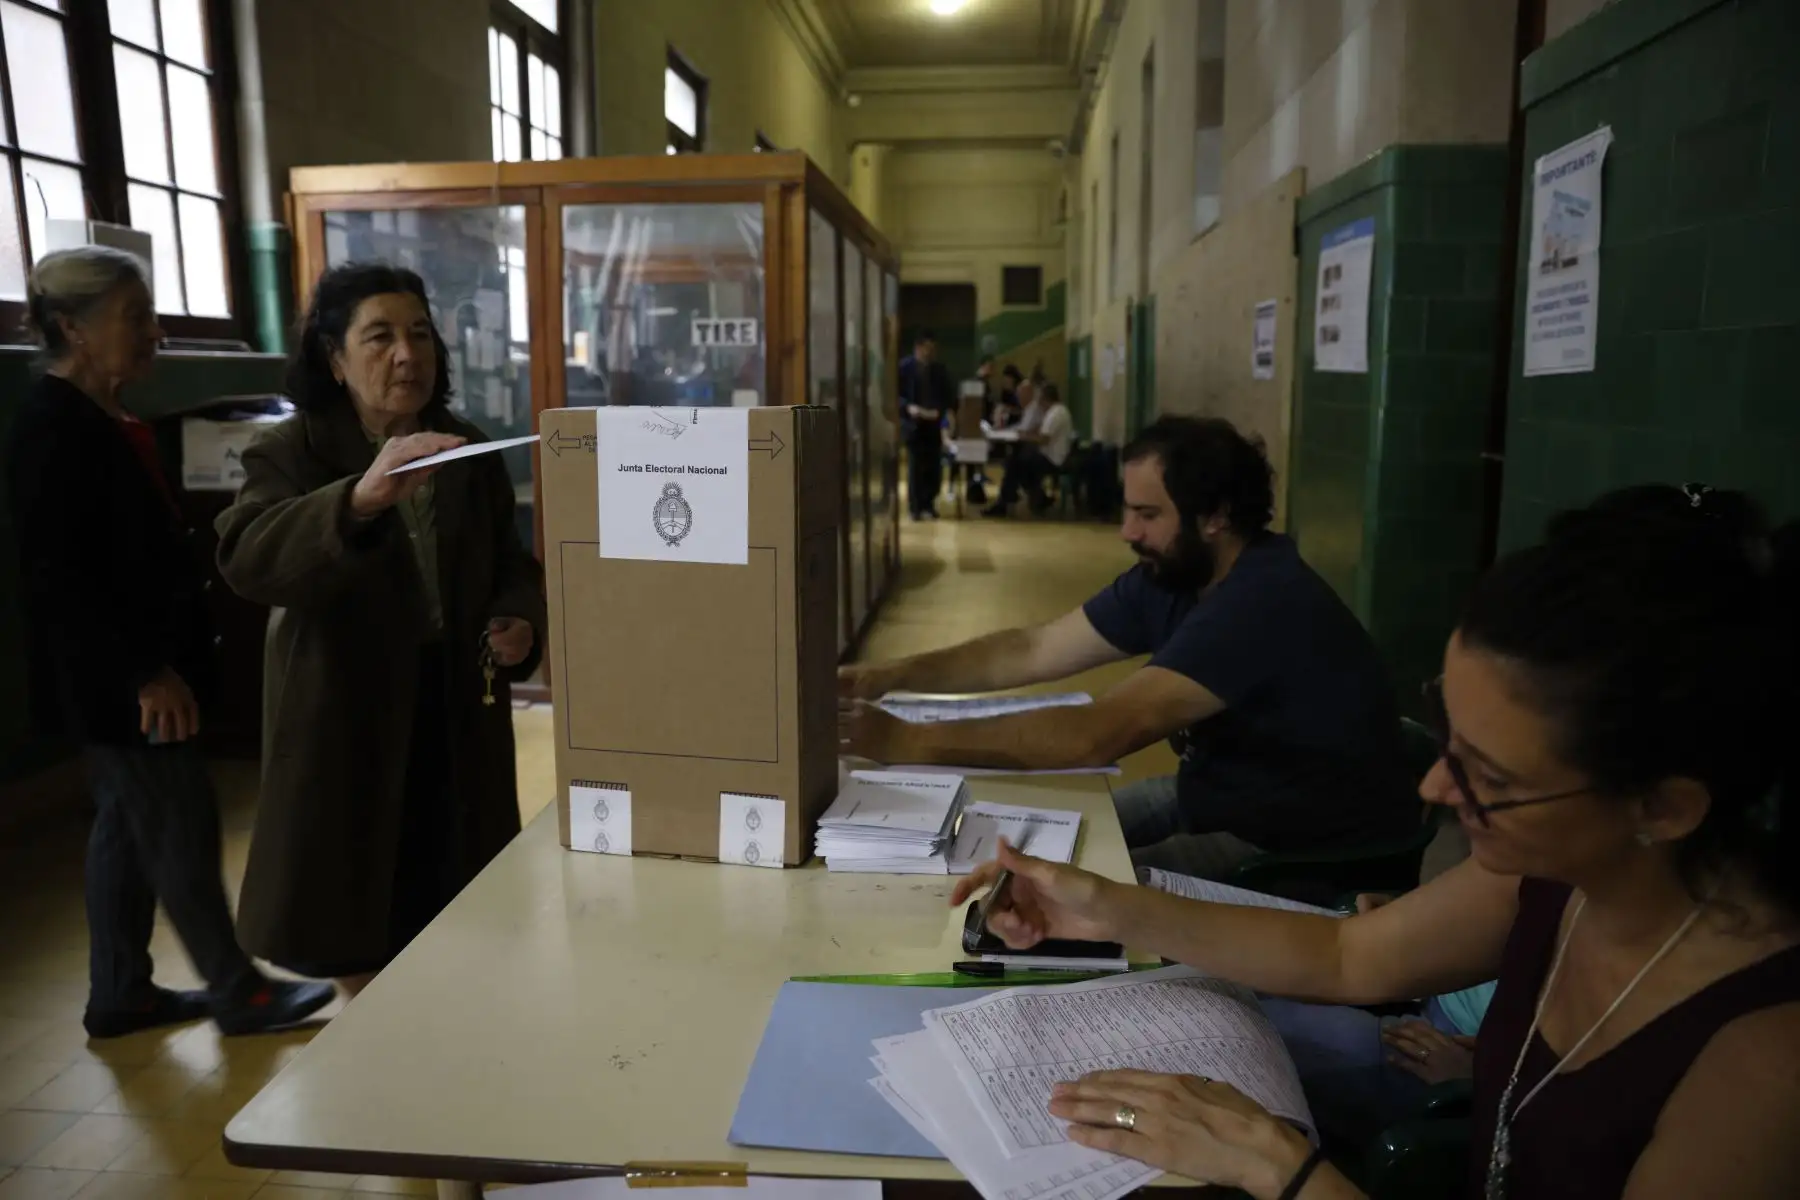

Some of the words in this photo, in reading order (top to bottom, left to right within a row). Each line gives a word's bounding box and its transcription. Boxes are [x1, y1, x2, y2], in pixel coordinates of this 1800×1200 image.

[696, 322, 752, 343] TIRE
[617, 464, 643, 473] Junta
[645, 464, 685, 474] Electoral
[687, 465, 728, 475] Nacional
